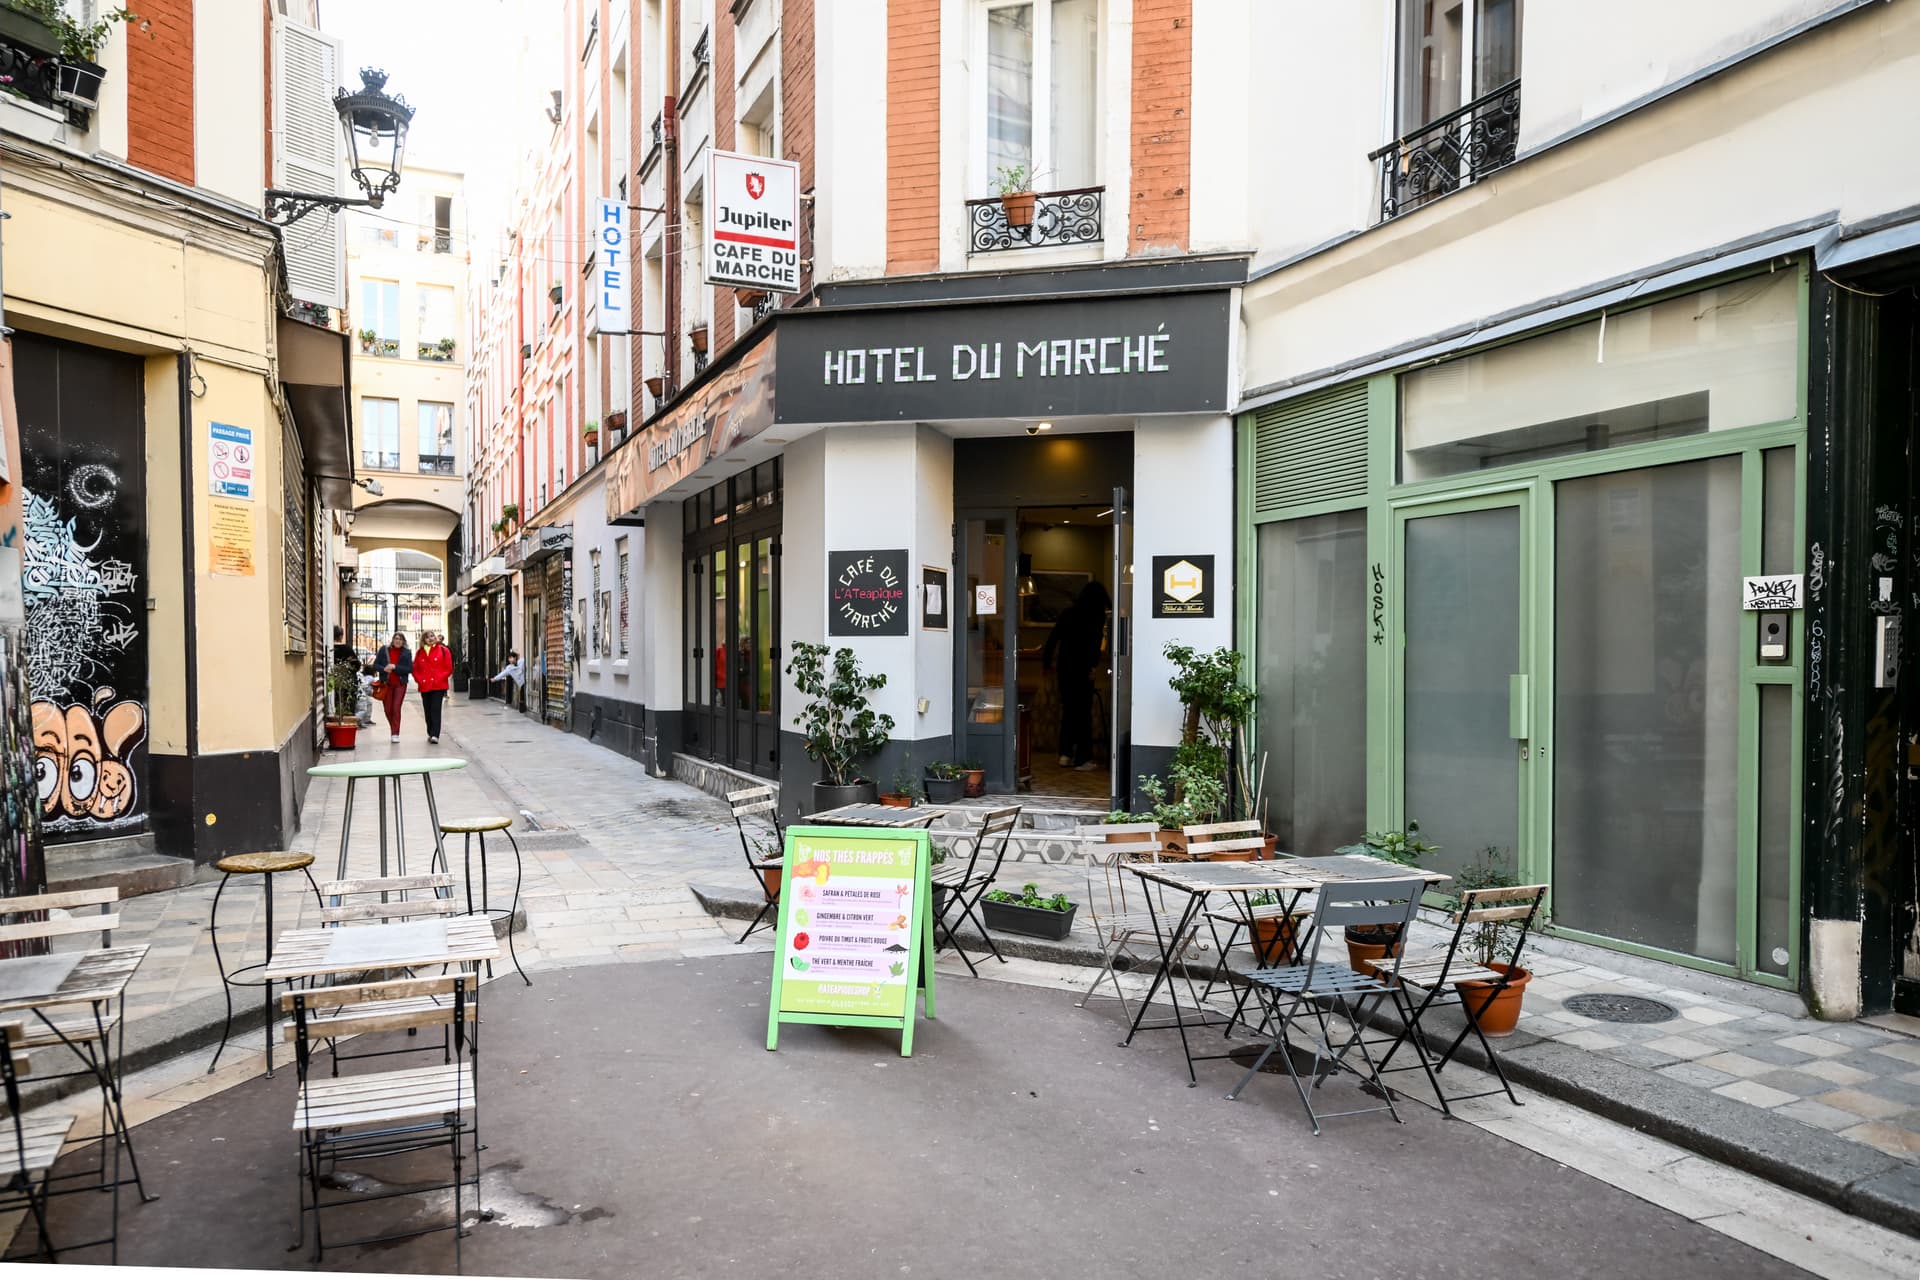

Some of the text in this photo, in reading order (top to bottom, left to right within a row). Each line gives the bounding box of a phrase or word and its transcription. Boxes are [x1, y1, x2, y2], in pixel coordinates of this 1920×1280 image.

[719, 206, 793, 232] Jupiler
[603, 204, 621, 311] HOTEL
[713, 242, 796, 267] CAFE DU
[715, 259, 795, 283] MARCHE
[824, 322, 1170, 385] HOTEL DU MARCHÉ
[839, 555, 899, 588] CAFÉ DU
[839, 600, 898, 629] MARCHÉ
[813, 848, 894, 865] NOS THÉS FRAPPÉS
[822, 889, 840, 897] SAFRAN
[870, 891, 881, 899] ROSE
[816, 912, 841, 920] GINGEMBRE
[846, 913, 862, 921] CITRON
[821, 958, 832, 966] VERT
[837, 959, 855, 967] MENTHE
